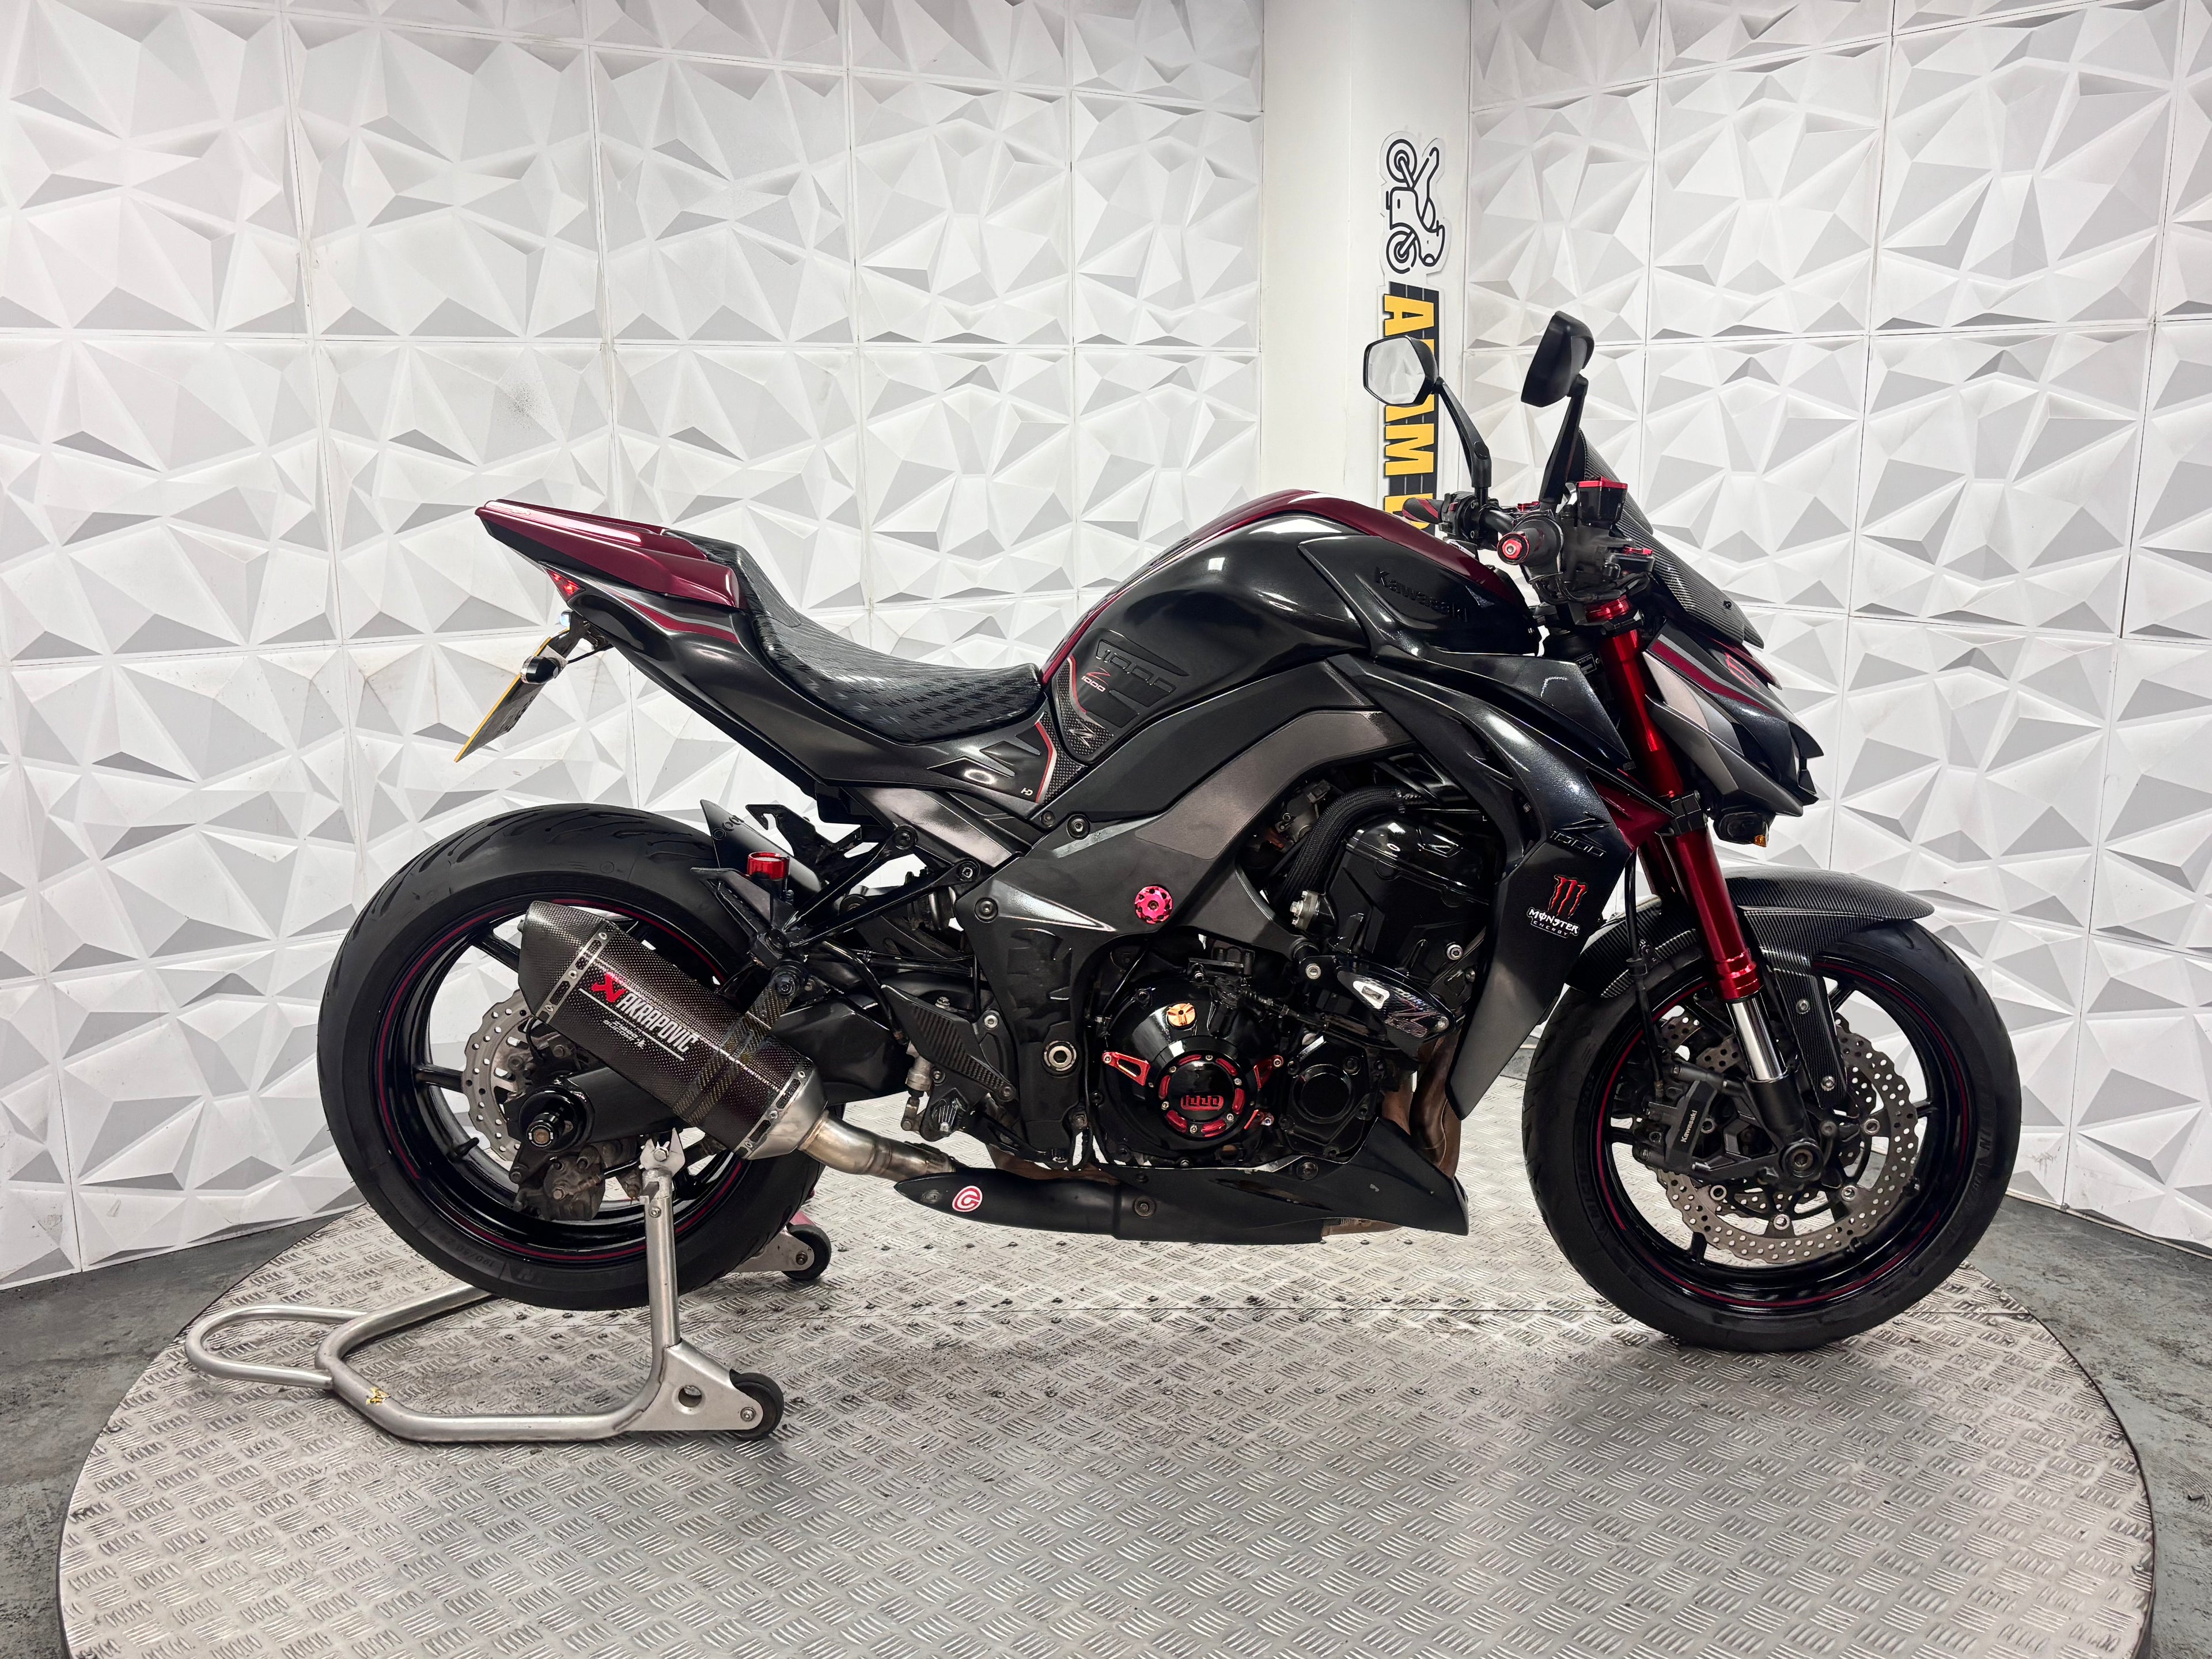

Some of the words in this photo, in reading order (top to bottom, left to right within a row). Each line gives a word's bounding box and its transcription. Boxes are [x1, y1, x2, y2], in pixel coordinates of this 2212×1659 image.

[1081, 676, 1107, 692] 1000
[1528, 908, 1580, 935] MONSTER
[1533, 920, 1568, 937] ENERGY
[1680, 1109, 1698, 1143] Kawasaki
